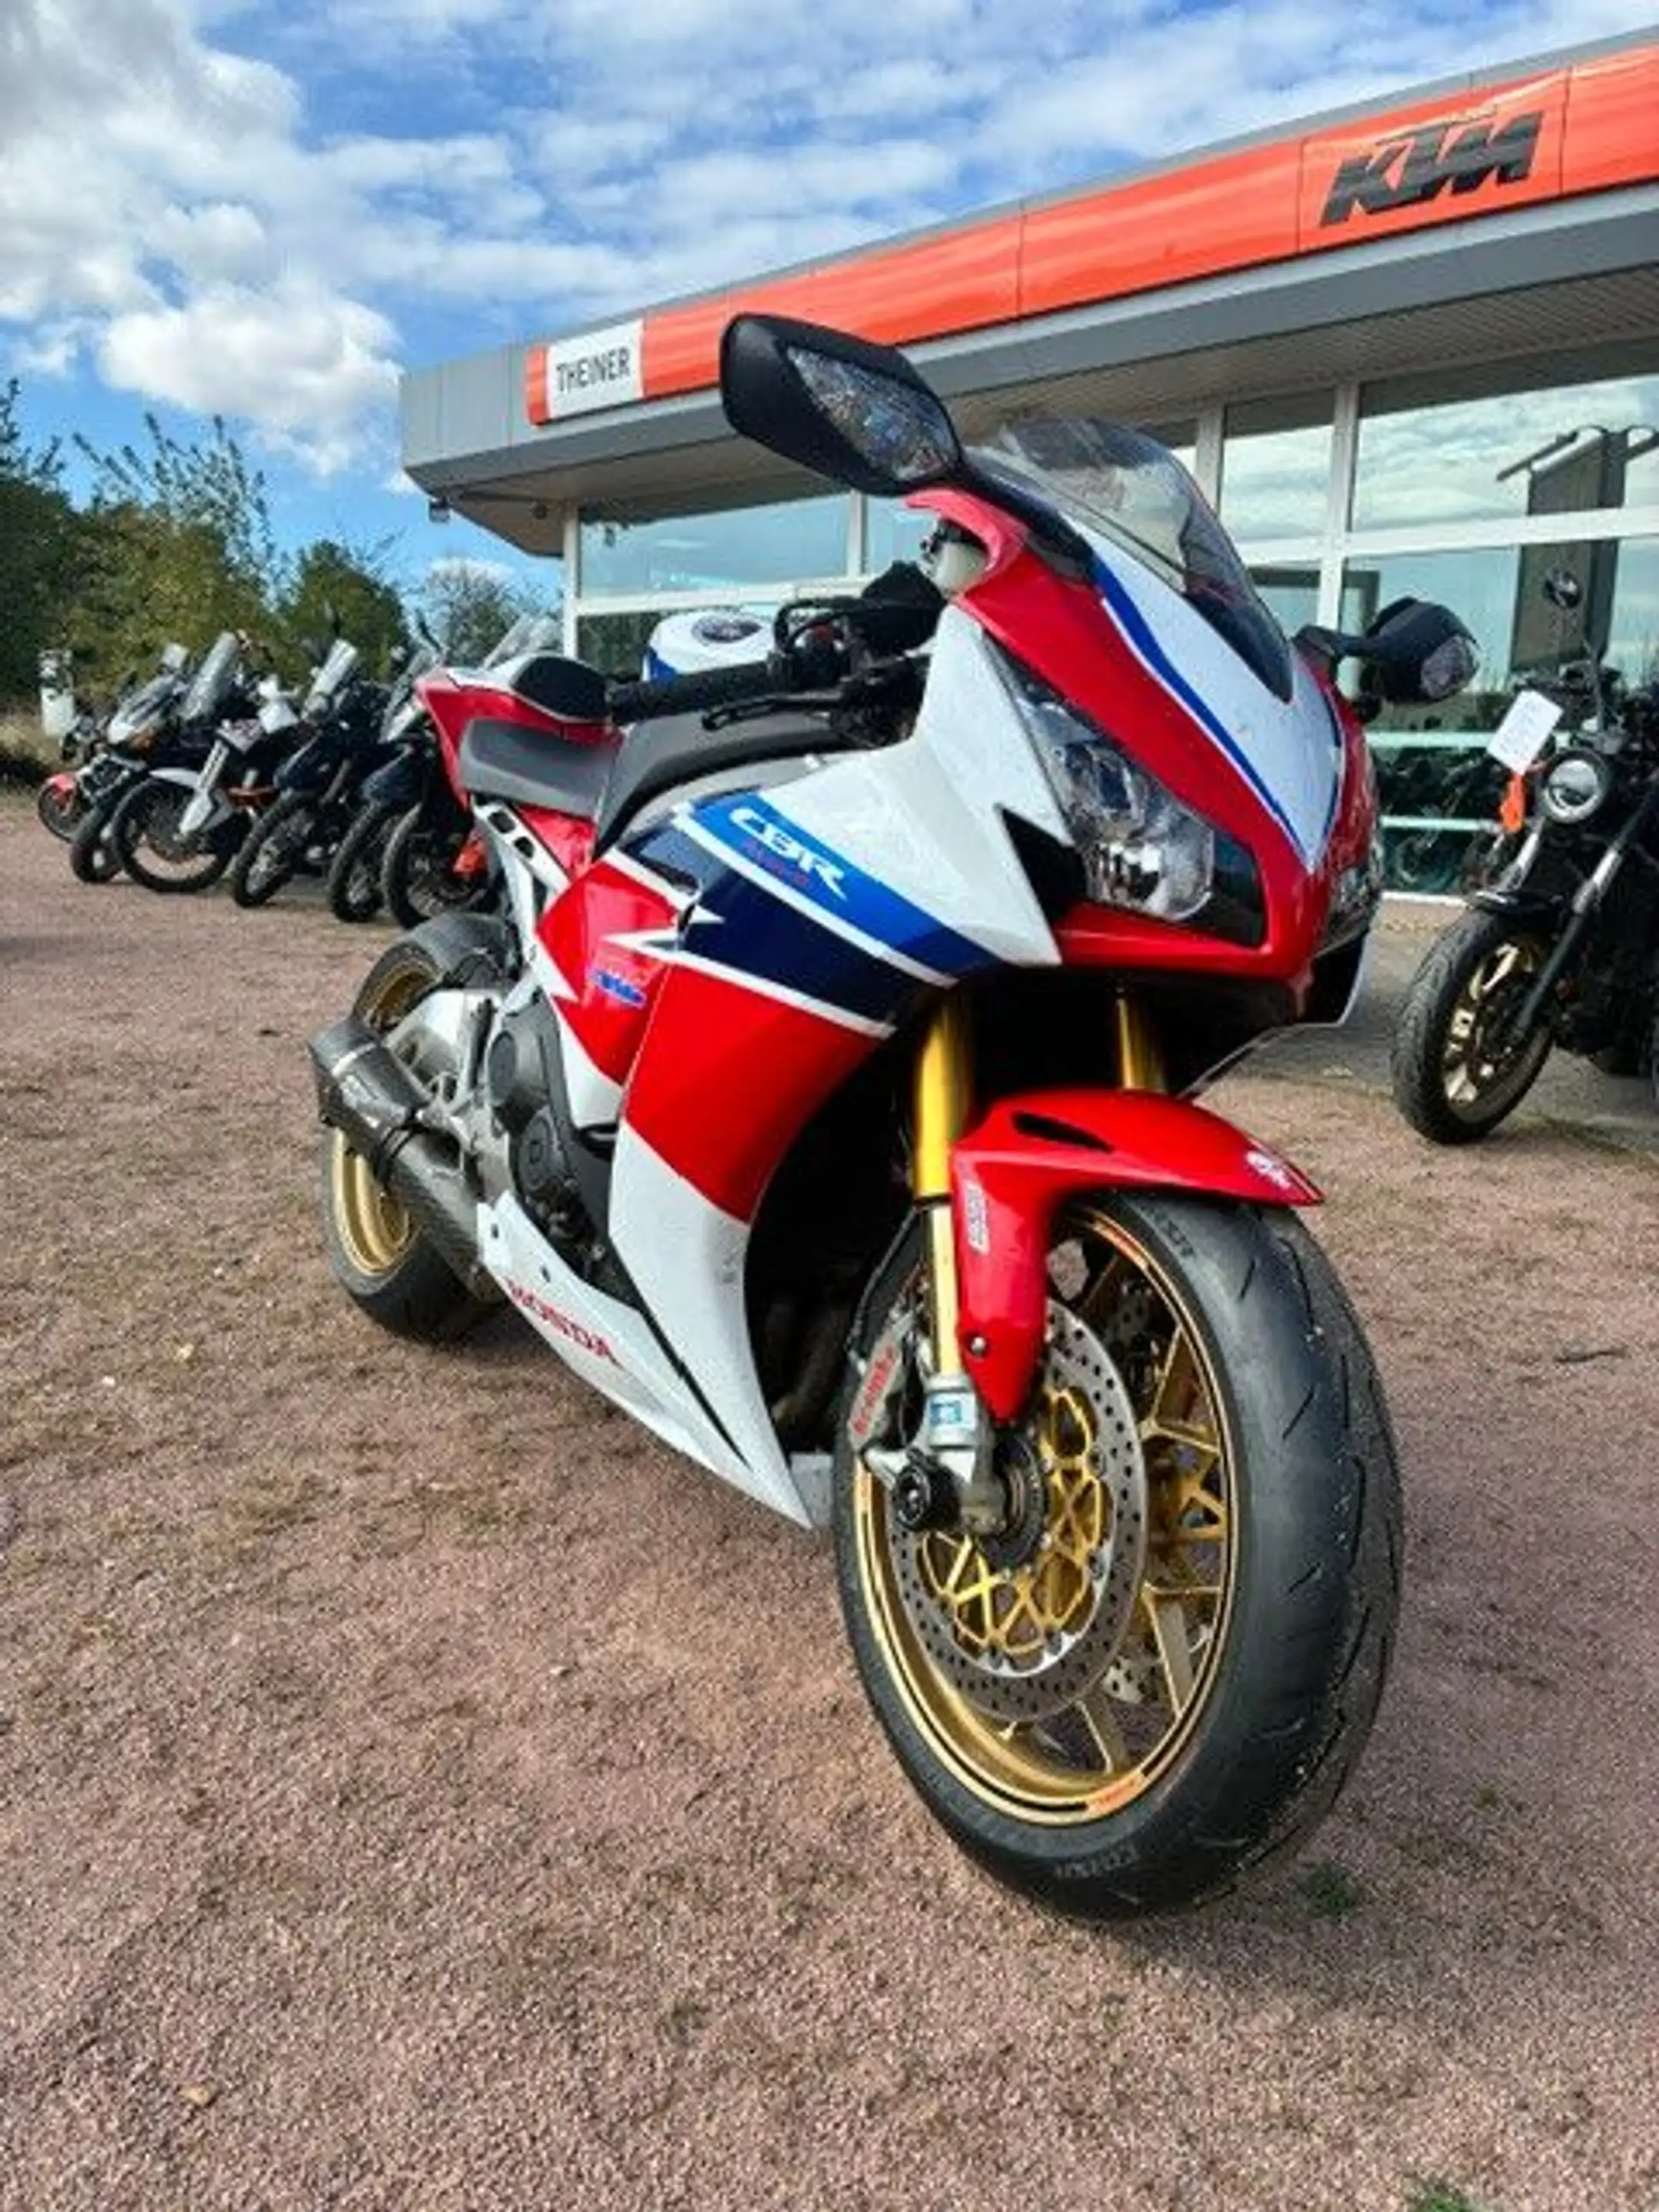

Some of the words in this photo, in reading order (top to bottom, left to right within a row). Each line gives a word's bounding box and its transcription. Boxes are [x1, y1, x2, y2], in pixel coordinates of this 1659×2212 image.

[1319, 111, 1543, 228] KTM
[555, 347, 631, 392] THEINER
[729, 808, 848, 902] CBR
[504, 1277, 611, 1357] HONDA
